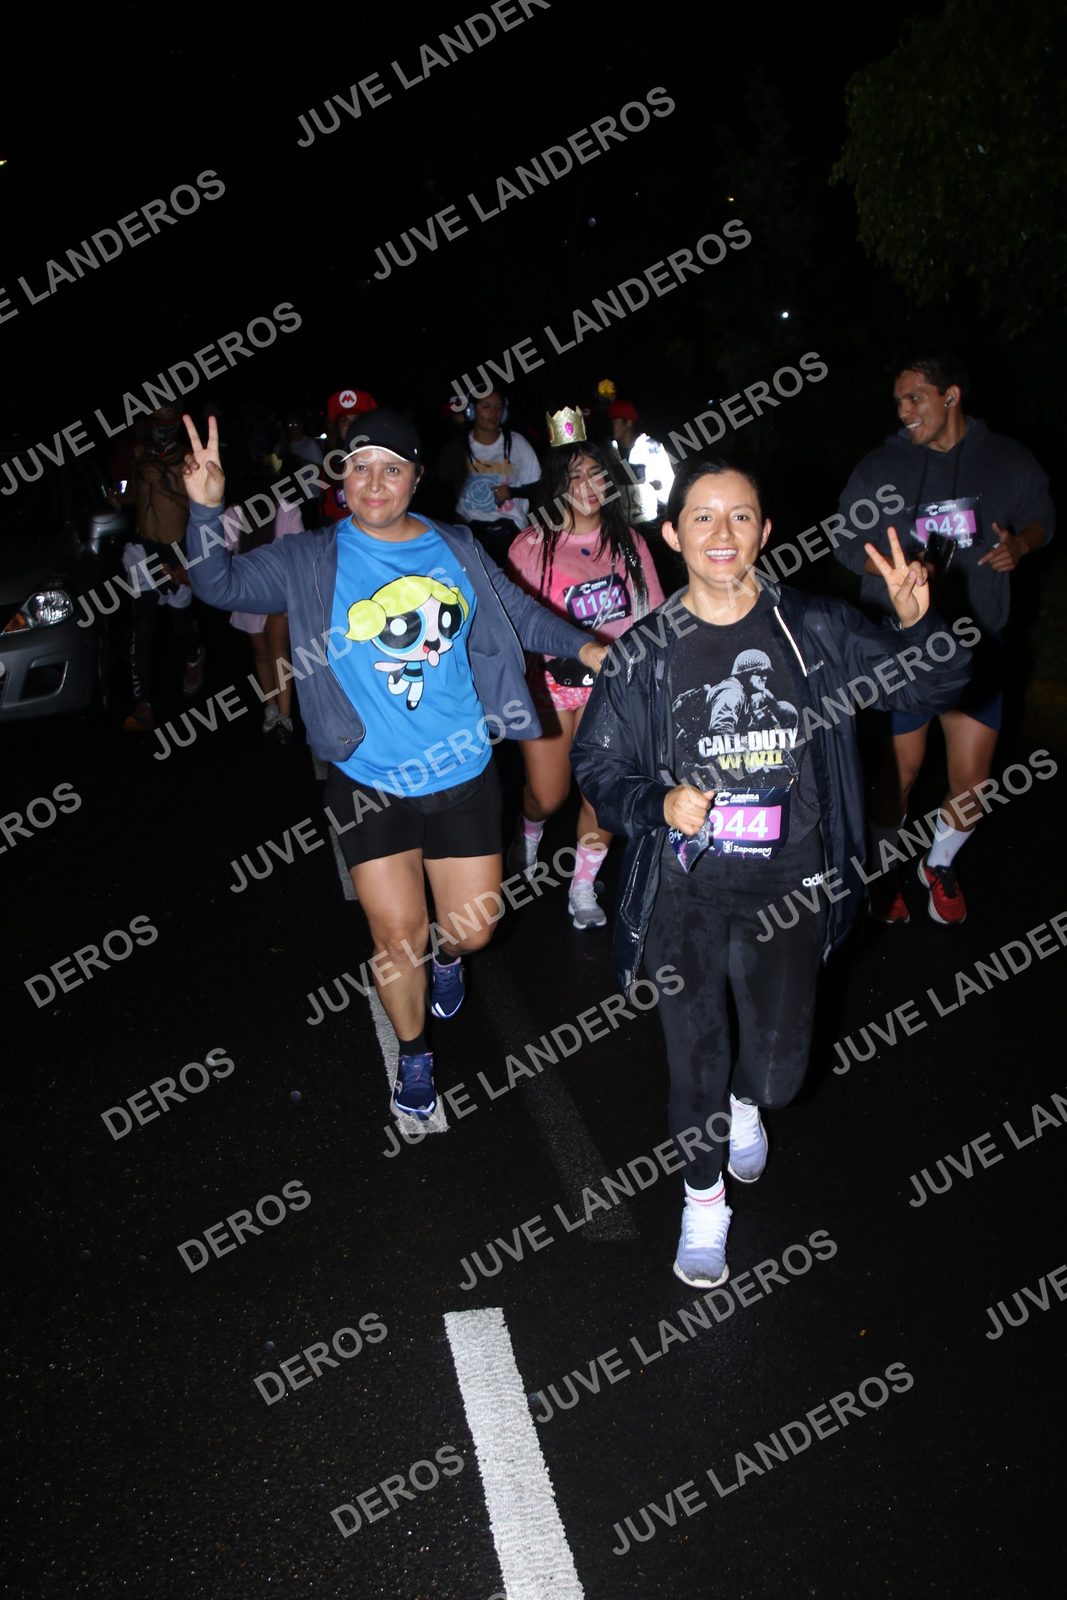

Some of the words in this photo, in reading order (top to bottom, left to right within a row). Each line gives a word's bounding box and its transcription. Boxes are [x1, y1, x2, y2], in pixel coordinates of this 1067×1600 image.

[925, 513, 966, 536] 942
[576, 586, 623, 619] 1161
[698, 733, 744, 757] CALL
[748, 727, 799, 751] DUTY
[719, 749, 784, 770] WWII
